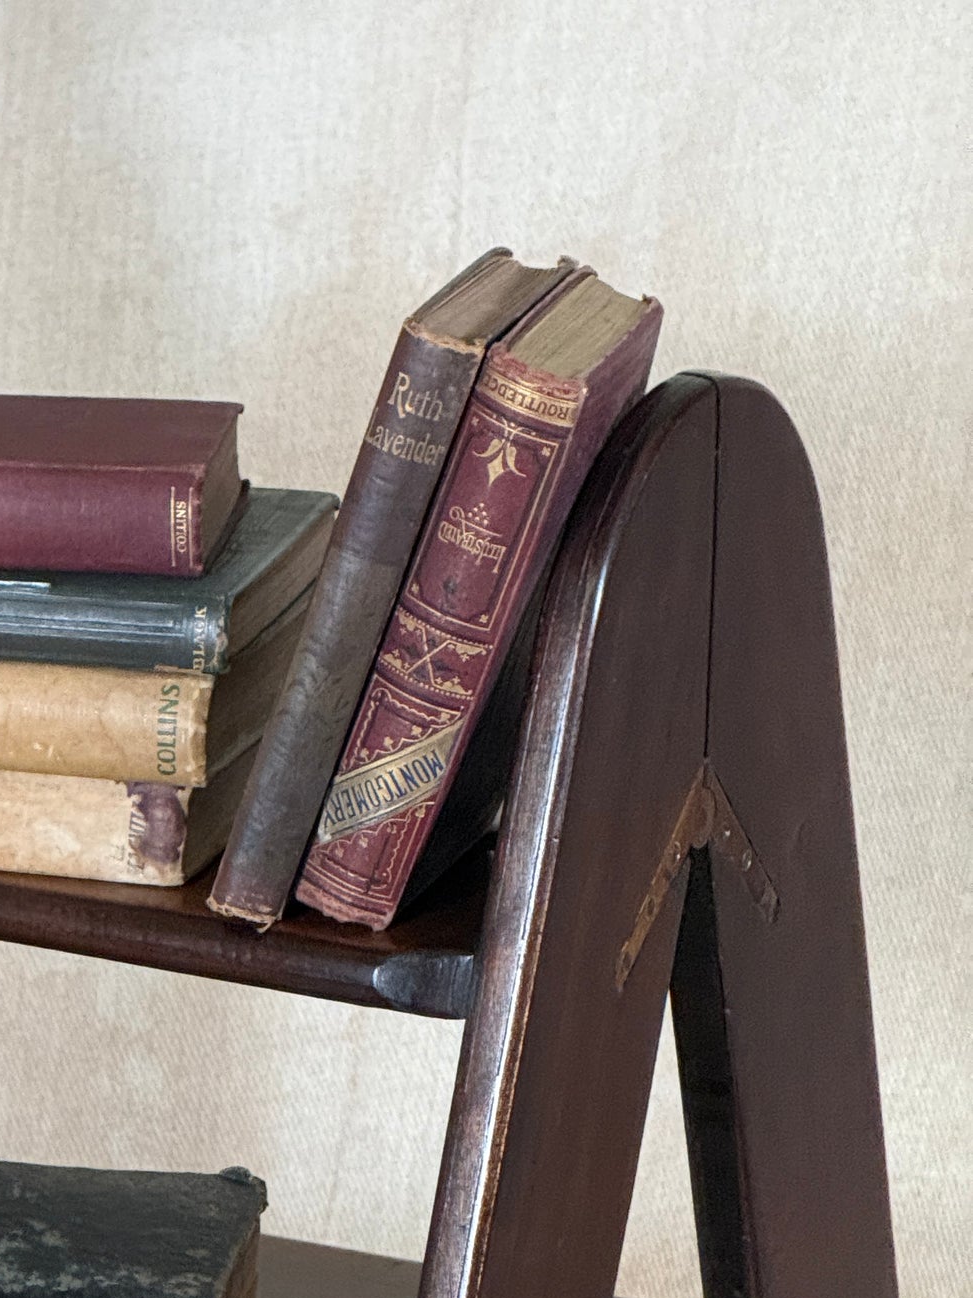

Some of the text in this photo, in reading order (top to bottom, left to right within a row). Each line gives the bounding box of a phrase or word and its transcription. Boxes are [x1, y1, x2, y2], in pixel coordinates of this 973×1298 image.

[387, 371, 443, 421] Ruth
[365, 408, 446, 466] Lavender
[175, 499, 187, 553] COLLINS
[192, 606, 209, 672] BLACK
[157, 683, 181, 776] COLLINS
[323, 749, 445, 830] MONTGOMERY
